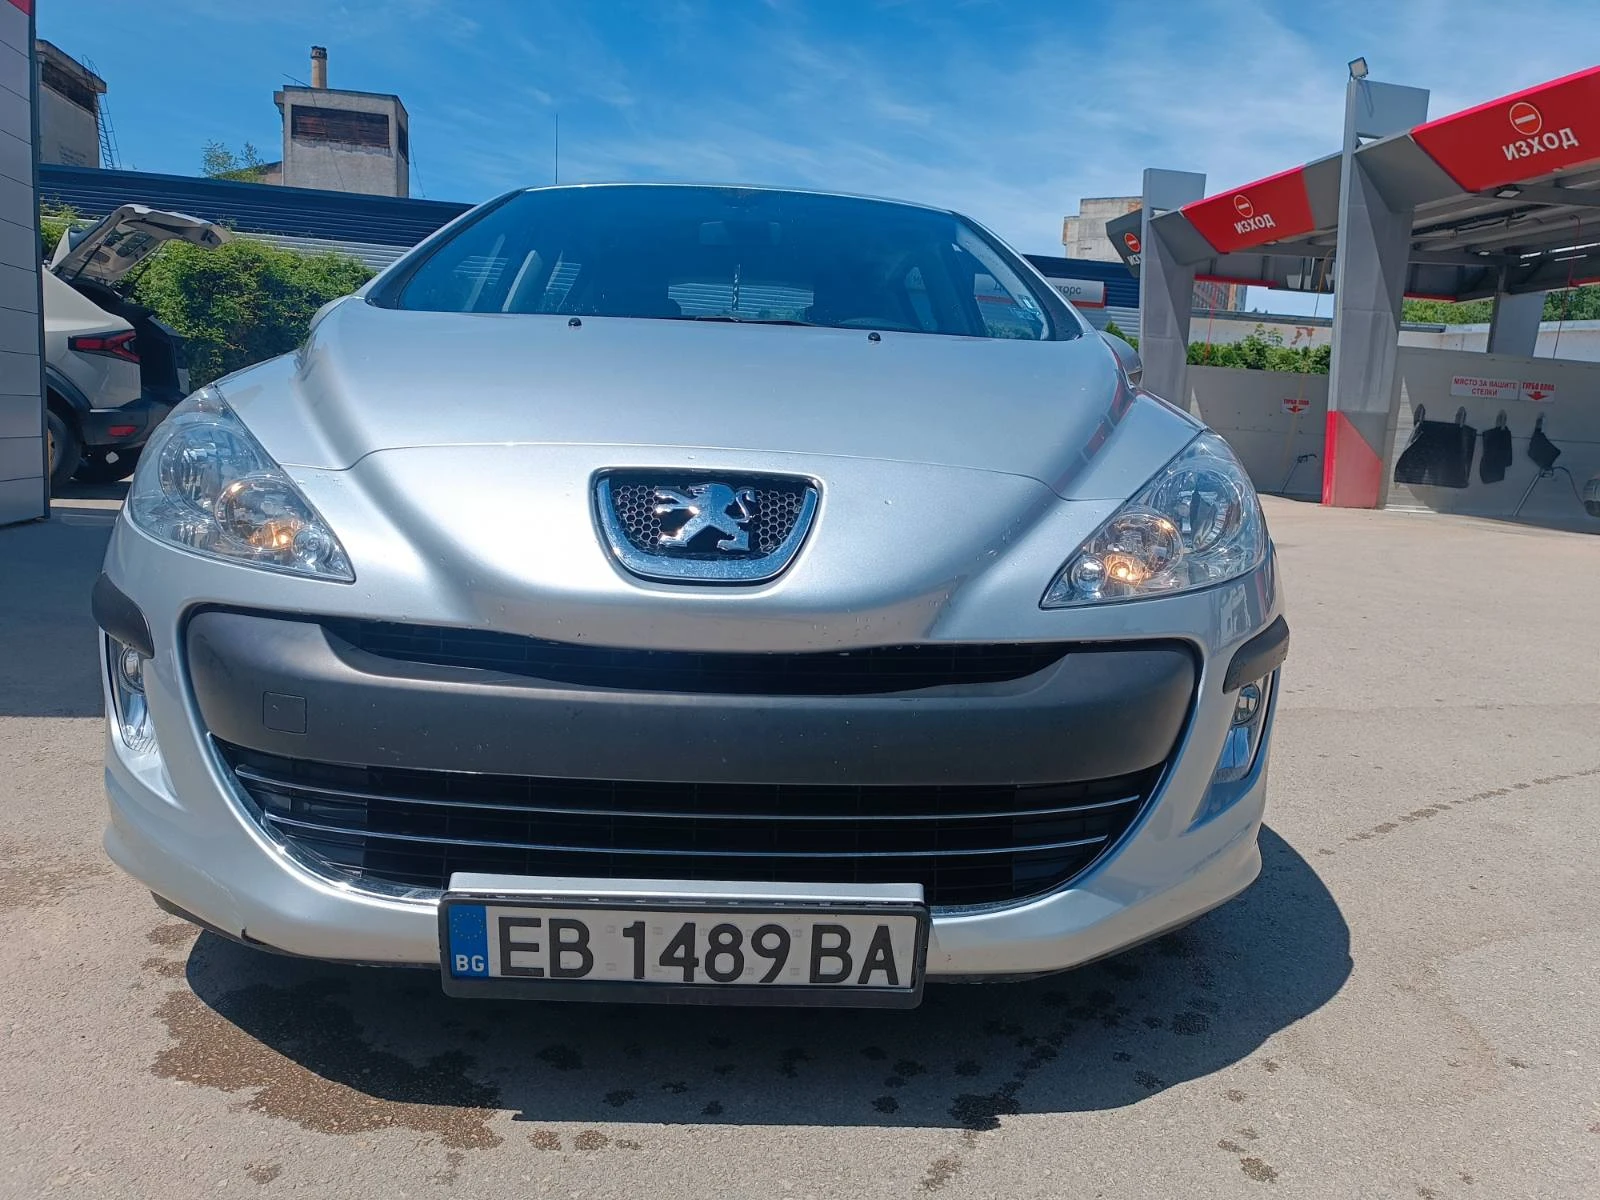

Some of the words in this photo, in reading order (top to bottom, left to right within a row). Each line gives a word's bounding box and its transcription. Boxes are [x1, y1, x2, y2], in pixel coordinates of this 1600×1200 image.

[1502, 127, 1579, 160] ИЗХОД
[1234, 213, 1276, 235] ИЗХОД
[1479, 379, 1488, 387] ЗА
[498, 916, 594, 978] EB
[622, 921, 791, 984] 1489
[809, 924, 900, 986] BA
[456, 955, 485, 972] BG
